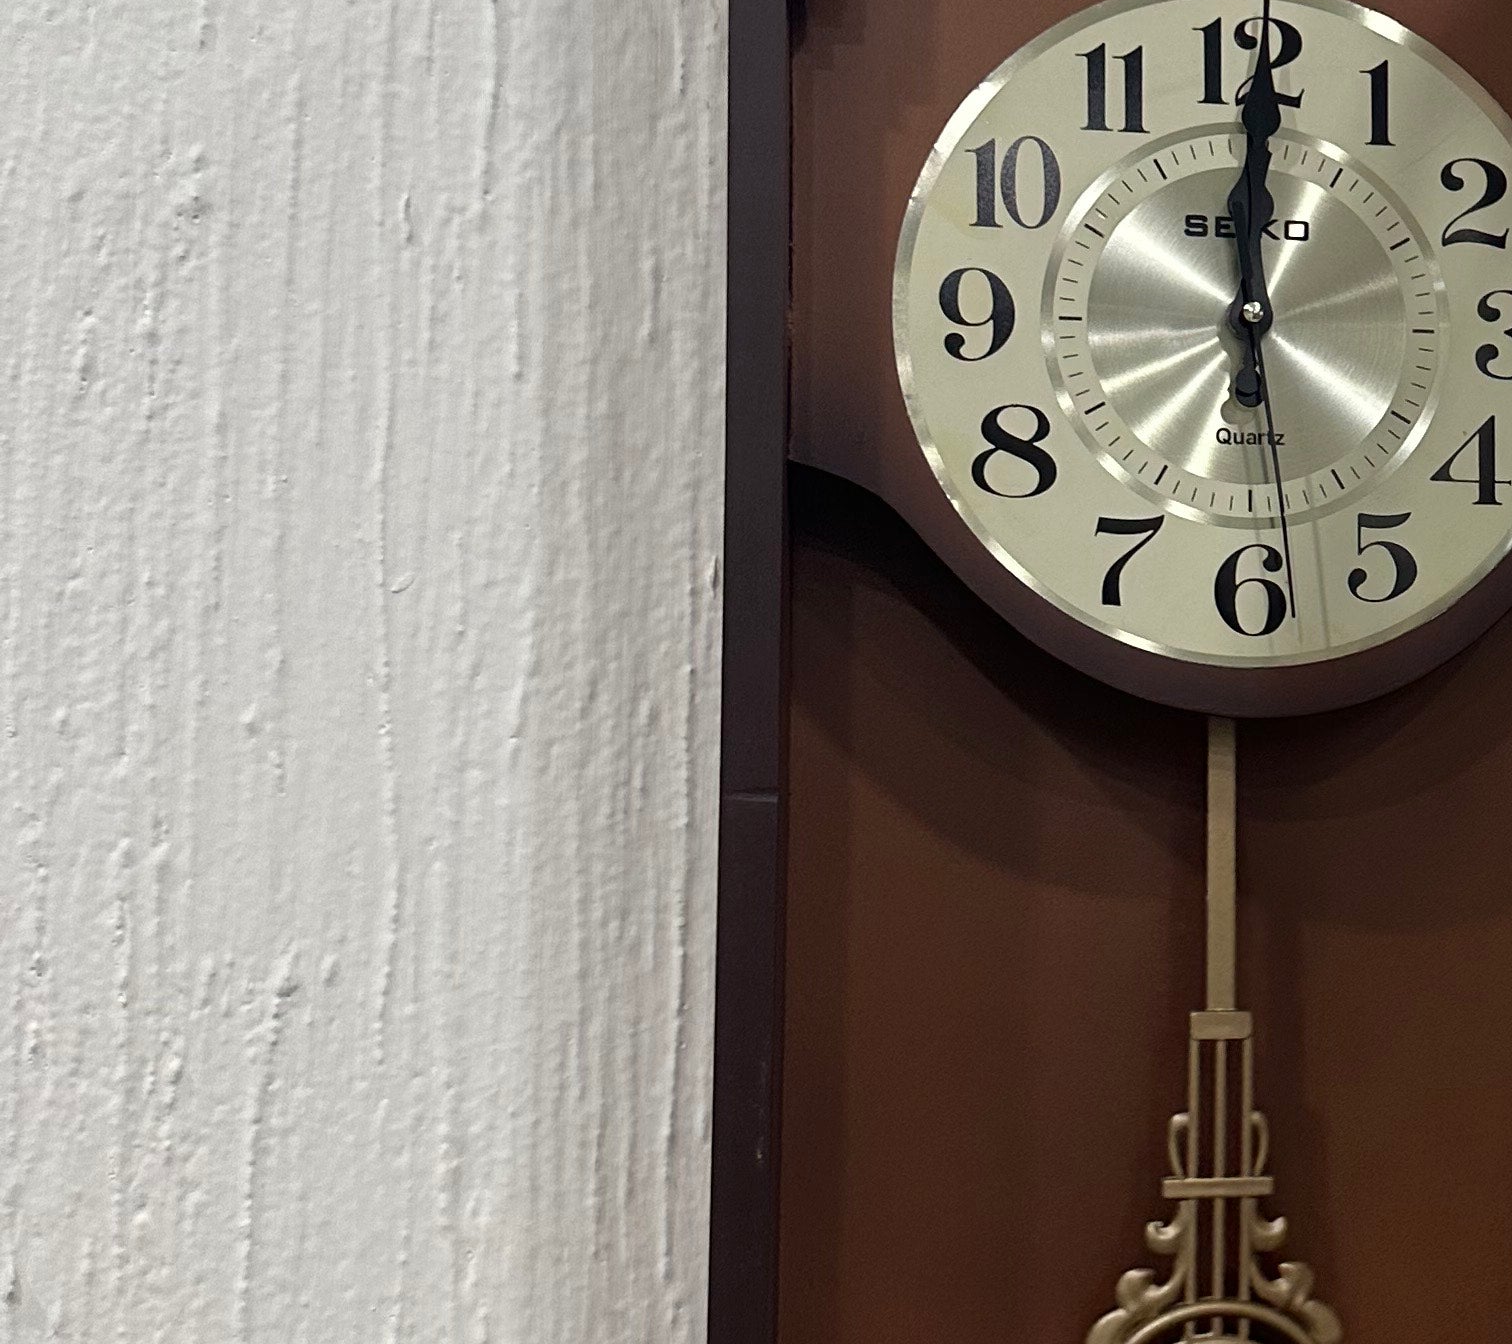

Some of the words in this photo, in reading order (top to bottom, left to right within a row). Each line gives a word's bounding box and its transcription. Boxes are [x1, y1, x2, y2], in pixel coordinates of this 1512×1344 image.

[1075, 43, 1150, 134] 11
[1191, 16, 1305, 109] 12
[1360, 59, 1396, 146] 1
[964, 135, 1061, 229] 10
[1440, 158, 1510, 249] 2
[1184, 214, 1309, 242] SEKO
[938, 267, 1016, 361] 9
[970, 404, 1057, 498] 8
[1429, 415, 1512, 506] 4
[1094, 514, 1165, 606] 7
[1214, 544, 1288, 637] 6
[1347, 512, 1418, 603] 5
